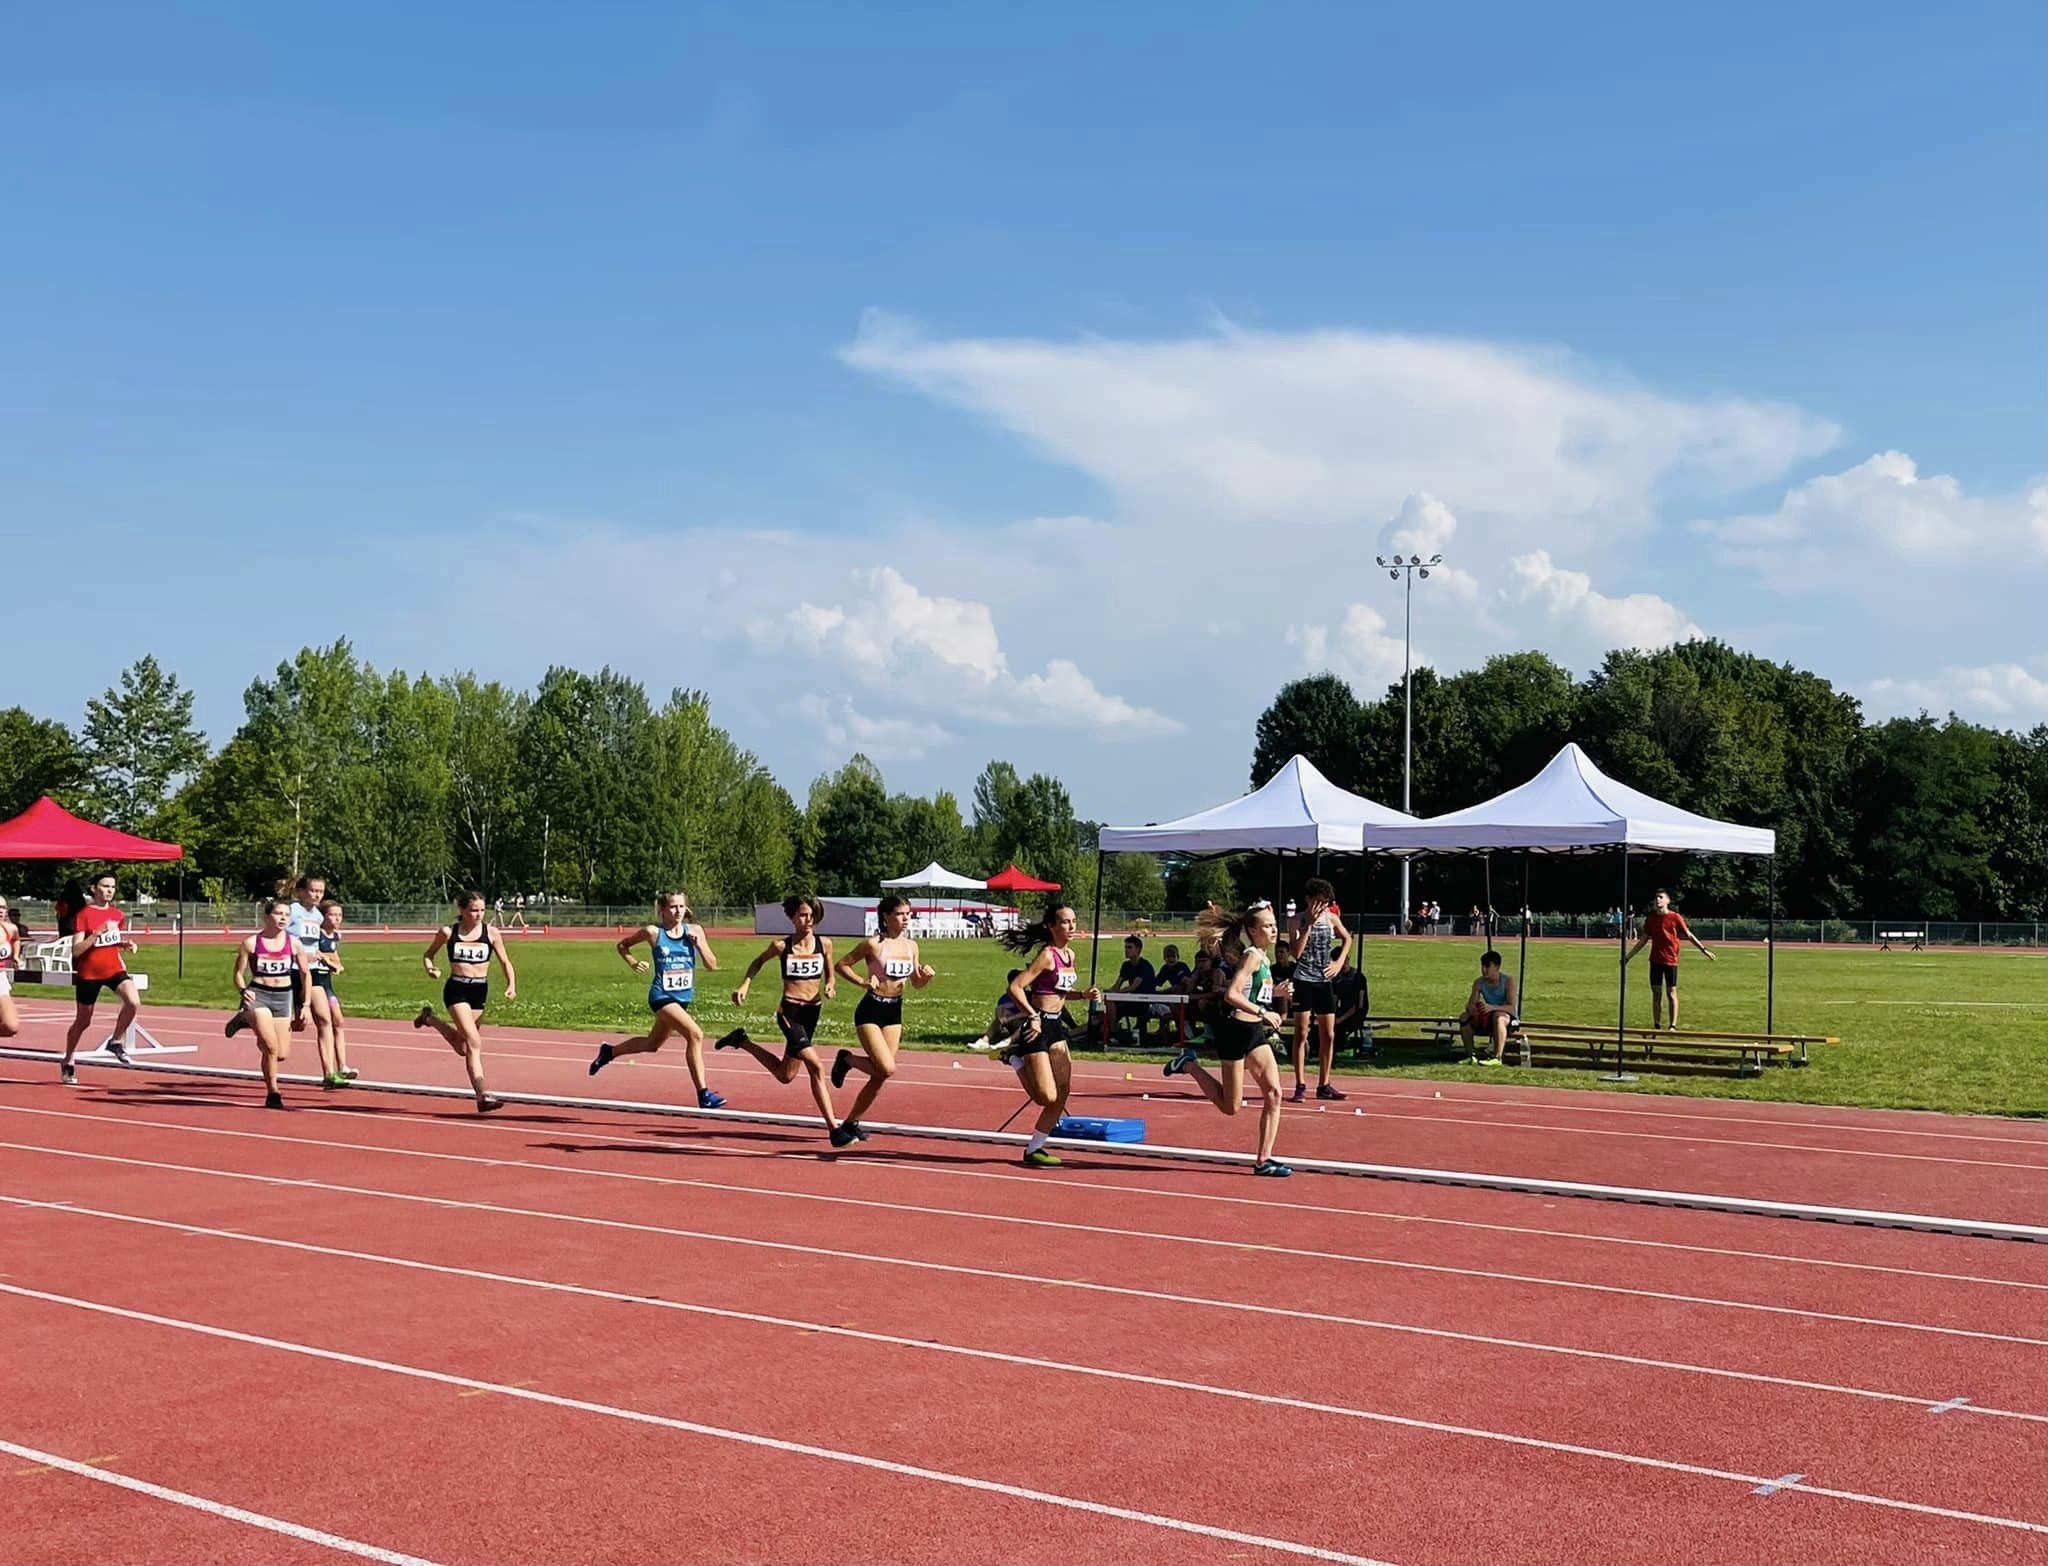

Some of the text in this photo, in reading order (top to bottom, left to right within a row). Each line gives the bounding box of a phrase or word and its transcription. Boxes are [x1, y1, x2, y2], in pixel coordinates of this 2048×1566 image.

[97, 932, 118, 944] 166
[459, 949, 483, 959] 114
[262, 962, 285, 972] 151
[791, 961, 819, 974] 155
[890, 963, 911, 974] 113
[667, 976, 689, 988] 146
